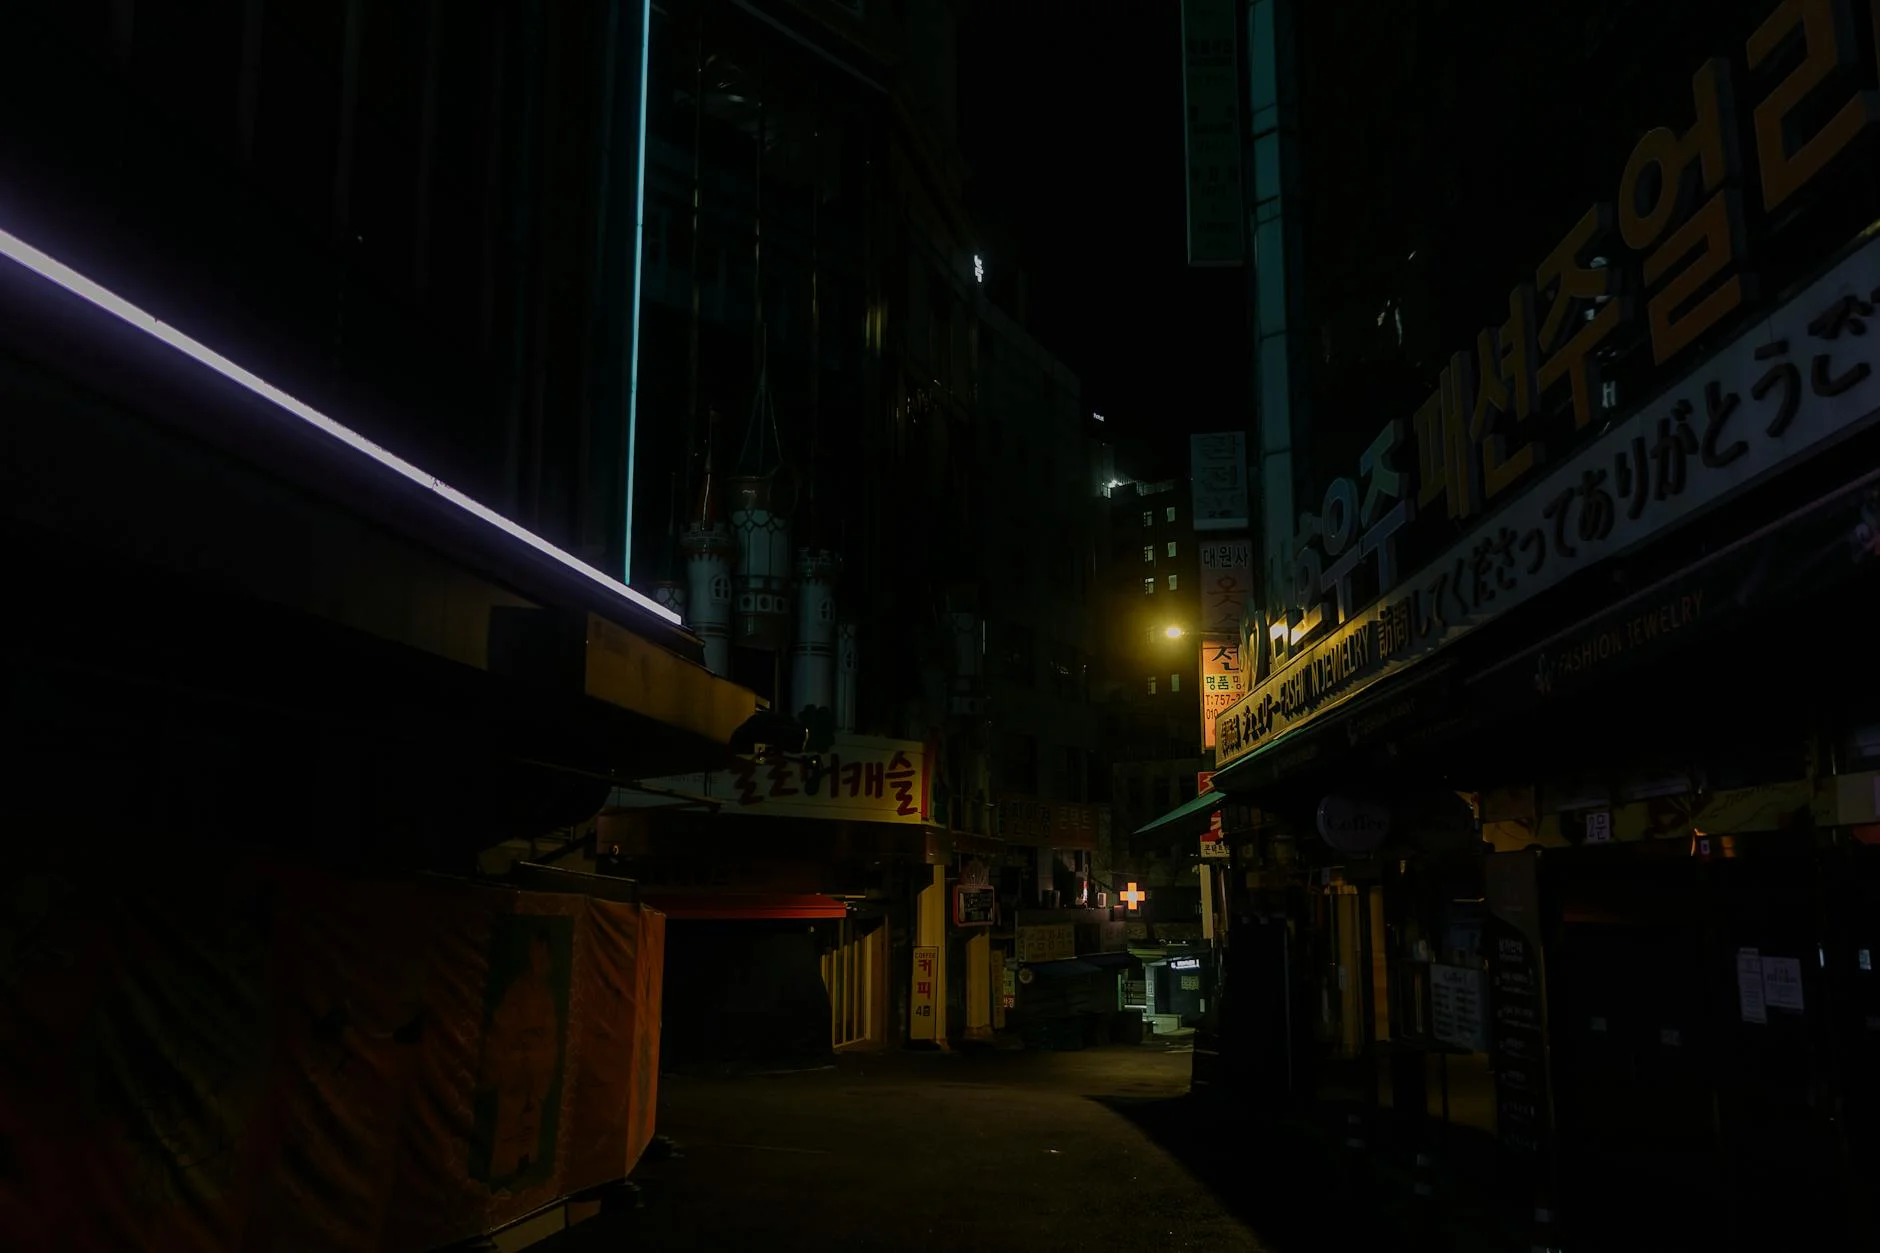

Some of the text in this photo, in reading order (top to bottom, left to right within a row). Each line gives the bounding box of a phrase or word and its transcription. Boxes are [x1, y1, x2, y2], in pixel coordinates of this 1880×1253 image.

[1203, 546, 1248, 568] 대원사
[1319, 623, 1371, 694] JEWELRY
[1557, 587, 1705, 678] FASHION JEWELRY
